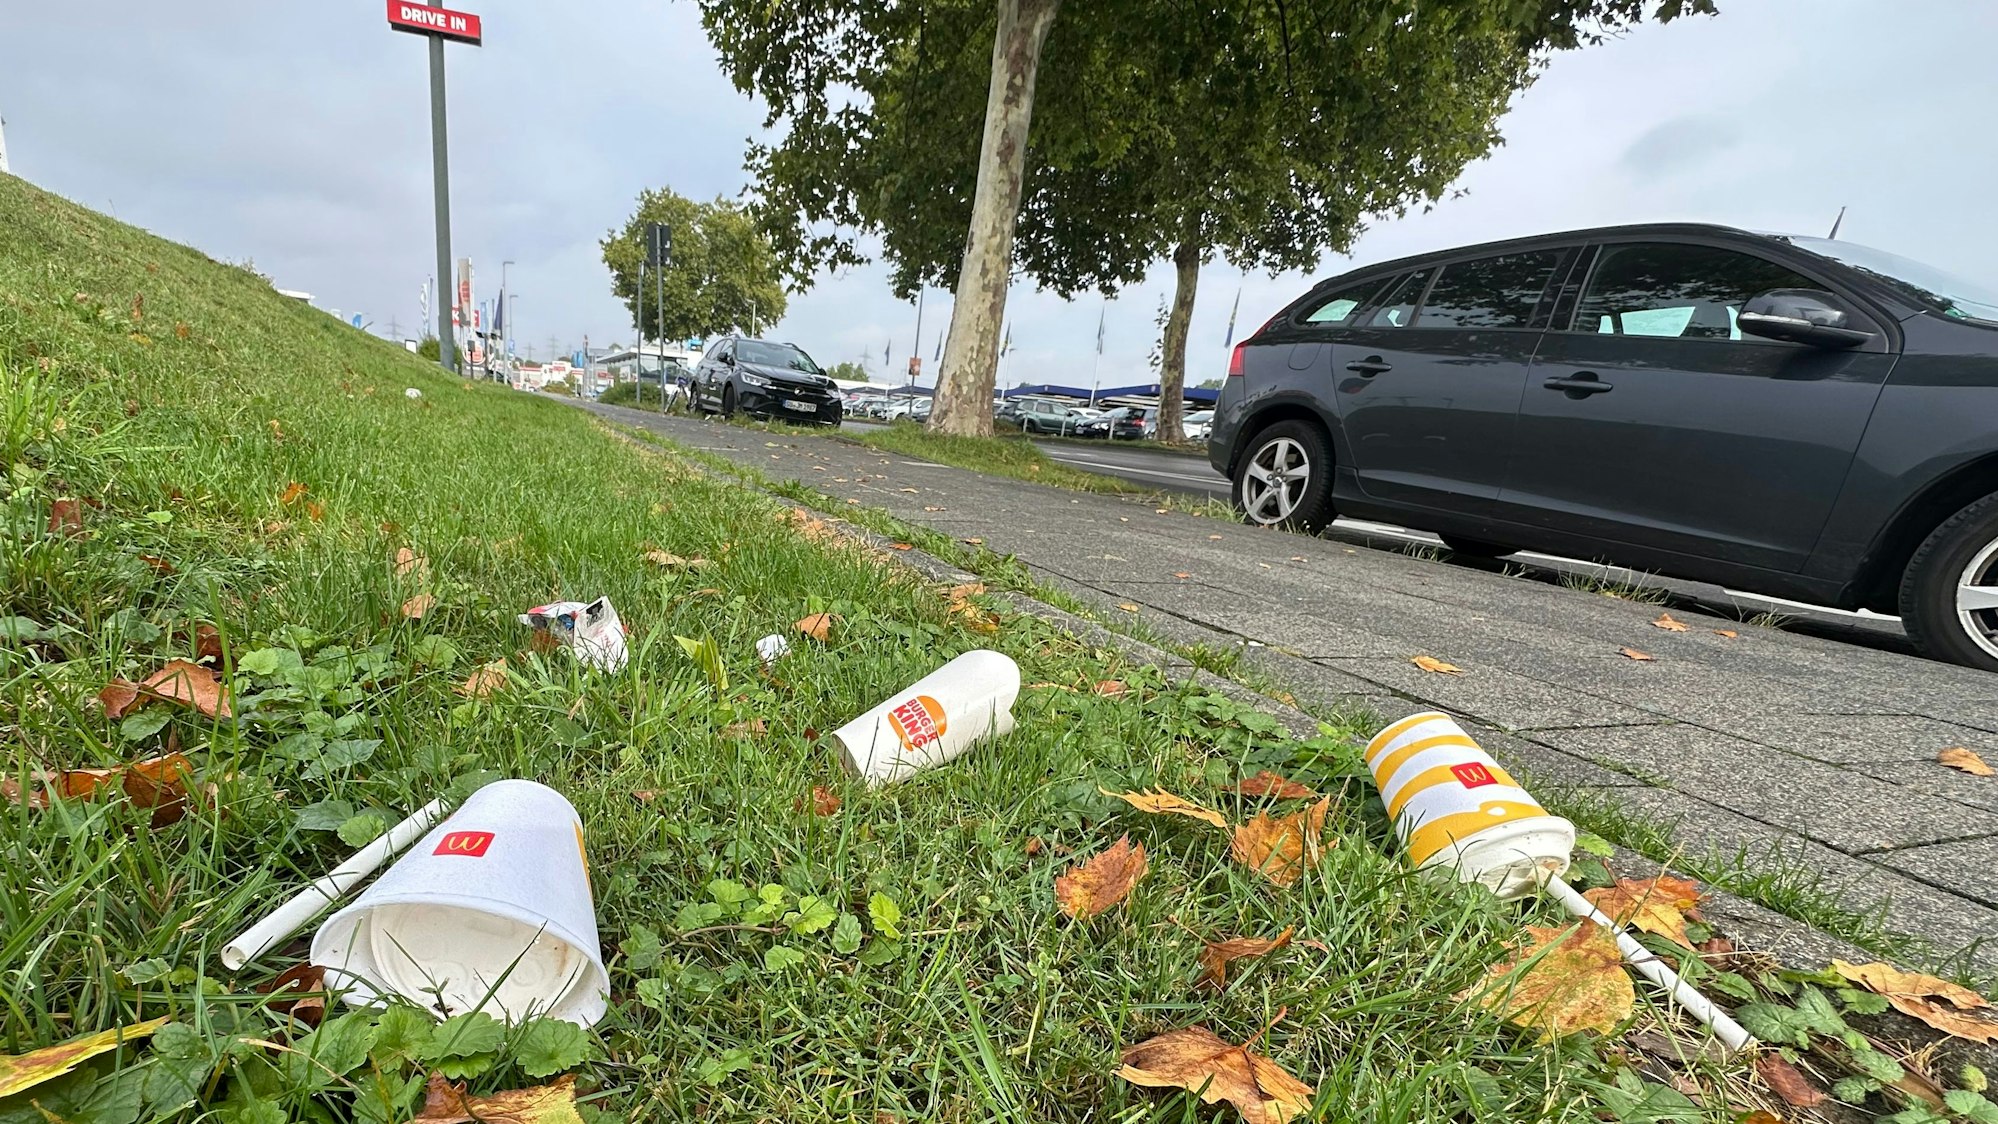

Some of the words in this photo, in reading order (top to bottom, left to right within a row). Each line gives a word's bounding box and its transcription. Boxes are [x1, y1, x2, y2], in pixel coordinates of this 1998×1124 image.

[400, 6, 446, 28] DRIVE
[450, 15, 467, 32] IN
[893, 704, 928, 748] KING
[905, 699, 939, 743] BURGER
